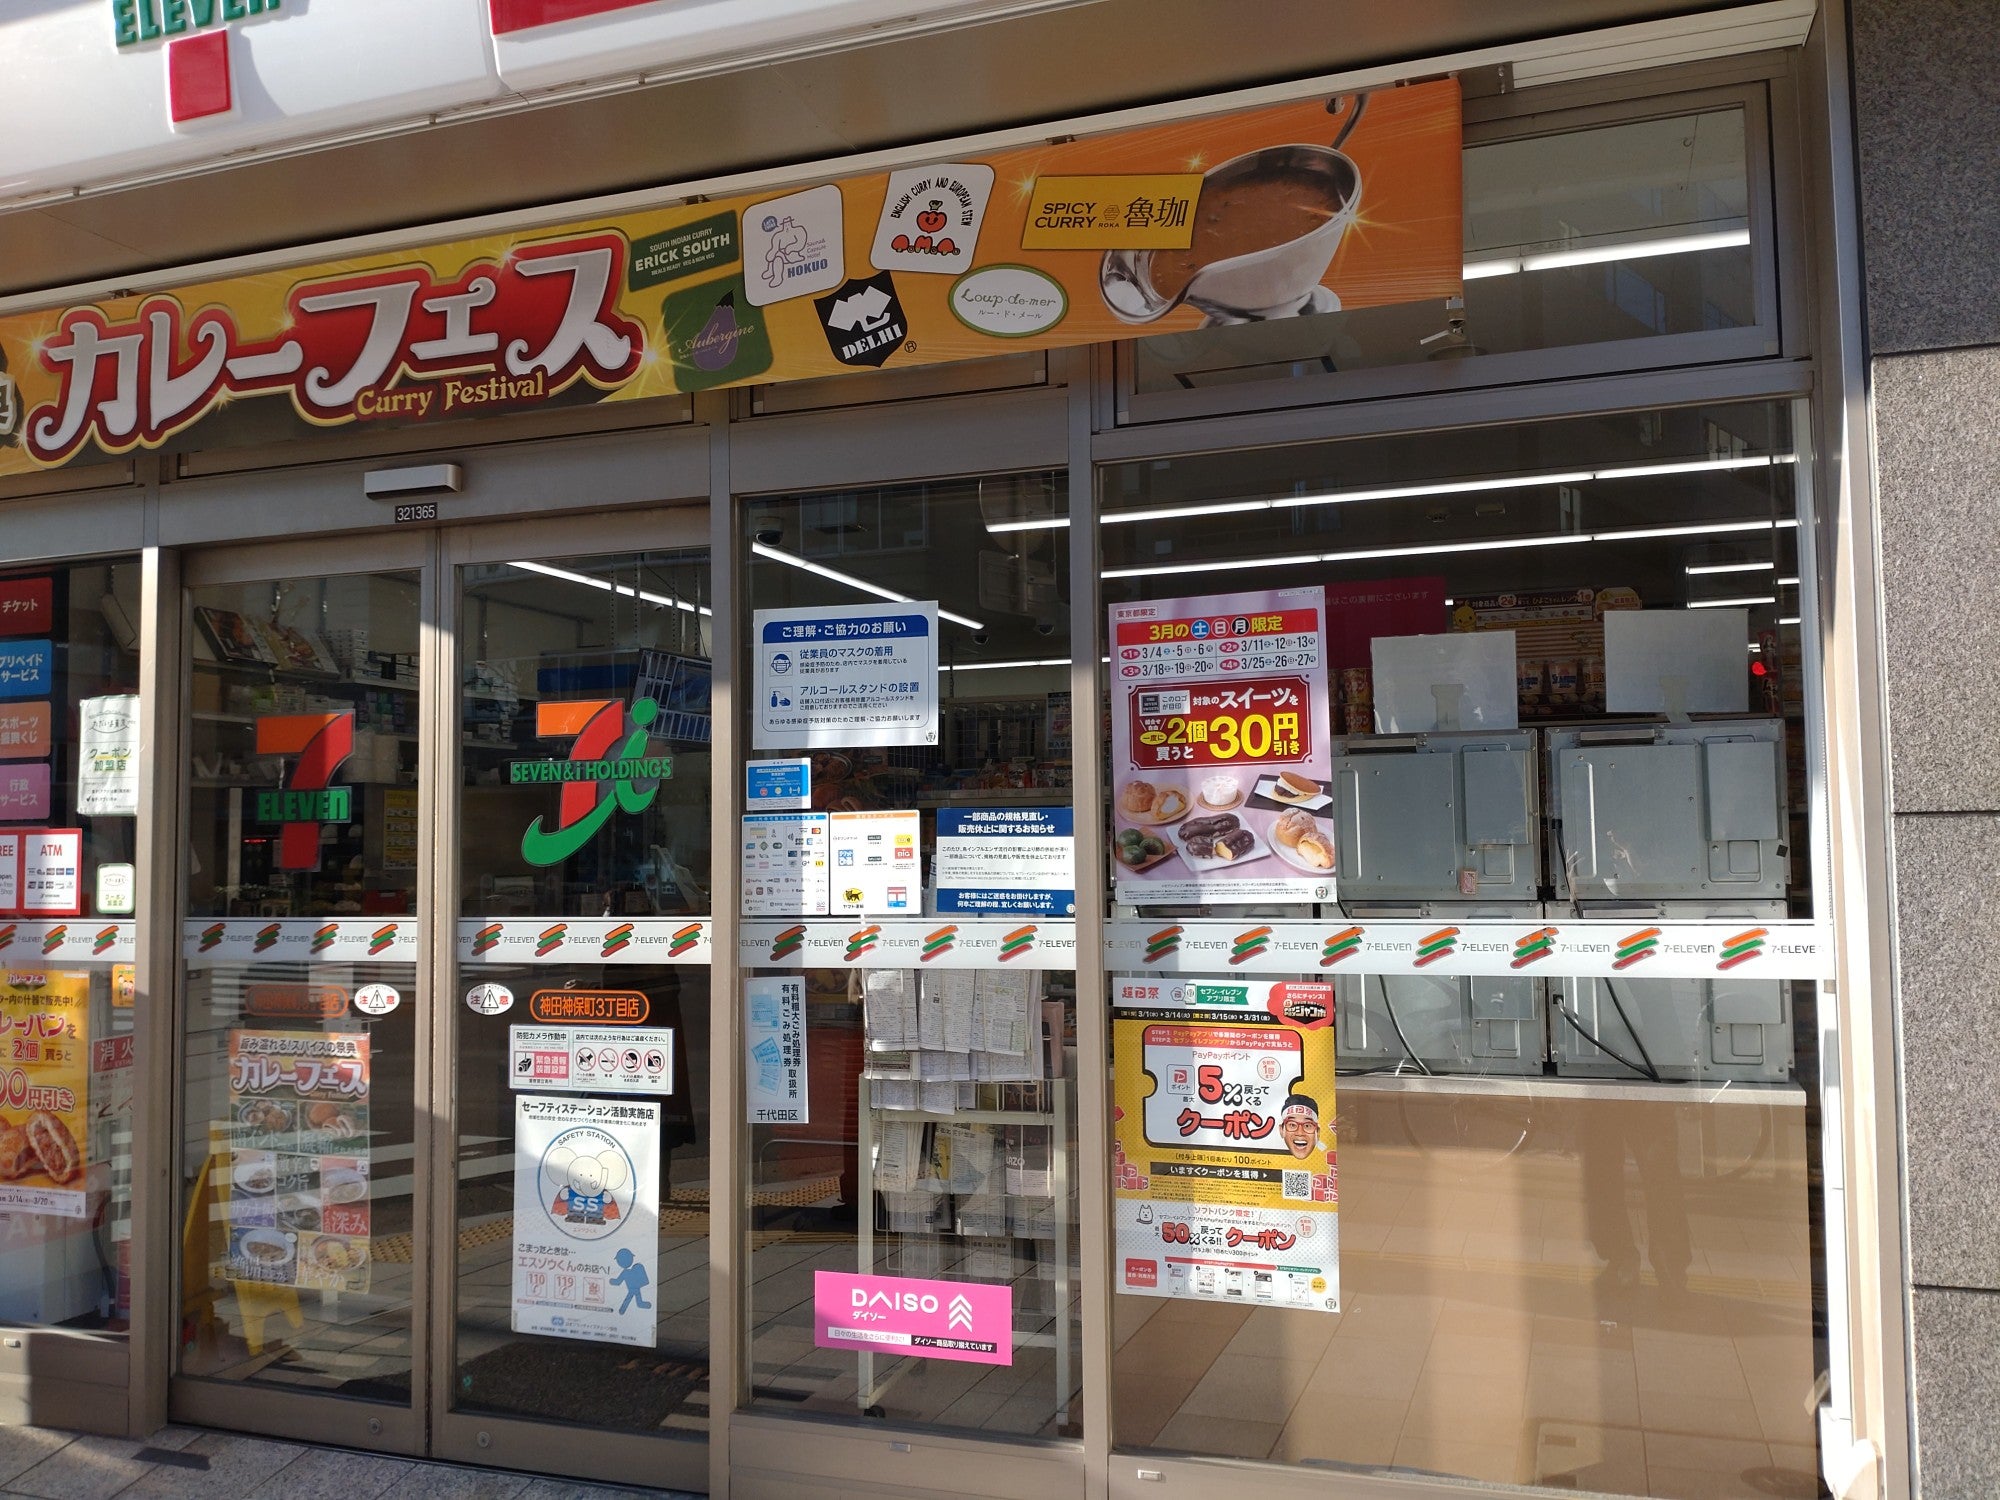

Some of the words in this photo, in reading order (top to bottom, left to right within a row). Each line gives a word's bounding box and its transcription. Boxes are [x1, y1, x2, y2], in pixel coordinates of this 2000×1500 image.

[911, 179, 931, 196] CURRY
[935, 177, 949, 188] AND
[1034, 215, 1097, 229] CURRY
[1123, 195, 1190, 229] 魯珈
[1042, 202, 1097, 215] SPICY
[649, 239, 670, 252] SOUTH
[670, 234, 690, 247] INDIAN
[691, 228, 713, 240] CURRY
[634, 250, 678, 272] ERICK
[682, 233, 730, 257] SOUTH
[787, 258, 829, 279] HOKUO
[684, 323, 754, 356] Aubergine
[842, 324, 903, 360] DELHI
[36, 248, 631, 450] カレーフェス
[357, 385, 433, 418] Curry
[443, 371, 545, 411] Festival
[397, 504, 436, 521] 321365
[3, 598, 38, 613] チケット
[1117, 608, 1156, 619] 東京都限定
[782, 621, 907, 639] ご理解・ご協力のお願い
[799, 645, 893, 660] 従業員のマスクの着用
[1, 668, 39, 682] サービス
[799, 681, 919, 696] アルコールスタンドの設置
[1162, 695, 1188, 703] このロゴ
[1193, 688, 1299, 710] 対象のスイーツを
[1167, 717, 1208, 743] 2個
[1156, 746, 1194, 761] 買うと
[1273, 740, 1300, 756] 引き
[585, 758, 671, 780] HOLDINGS
[0, 794, 38, 807] サービス
[958, 824, 1055, 834] 販売休止に関するお知らせ
[40, 845, 62, 857] ATM
[470, 994, 480, 1005] 注
[539, 996, 640, 1018] 神田神保町3丁目店
[1206, 995, 1236, 1004] アプリ限定
[781, 984, 792, 1067] 有料ごみ処理券
[790, 984, 801, 1067] 有料粗大ごみ処理券
[516, 1032, 567, 1041] 防犯カメラ作動中
[13, 1038, 39, 1061] 2個
[45, 1049, 72, 1061] 買うと
[1192, 1051, 1251, 1061] PayPayポイント
[232, 1056, 367, 1093] カレーフェス
[788, 1069, 798, 1098] 取扱所
[1198, 1064, 1243, 1106] 5%
[1244, 1084, 1270, 1095] 戻って
[1245, 1096, 1262, 1106] くる
[522, 1101, 654, 1120] セーフティステーション活動実施店
[756, 1109, 799, 1121] 千代田区
[1177, 1107, 1275, 1140] クーポン
[557, 1130, 584, 1146] SAFETY
[586, 1130, 616, 1149] STATION
[1169, 1164, 1258, 1178] いますぐクーポンを獲得
[573, 1196, 599, 1213] SS
[1195, 1206, 1254, 1218] ソフトバンク限定!
[1161, 1221, 1201, 1245] 50%
[1200, 1225, 1223, 1236] 戻って
[1225, 1226, 1296, 1251] クーポン
[528, 1273, 545, 1285] 110
[556, 1276, 574, 1287] 119
[851, 1288, 939, 1314] DAISO
[852, 1310, 887, 1323] ダイソー
